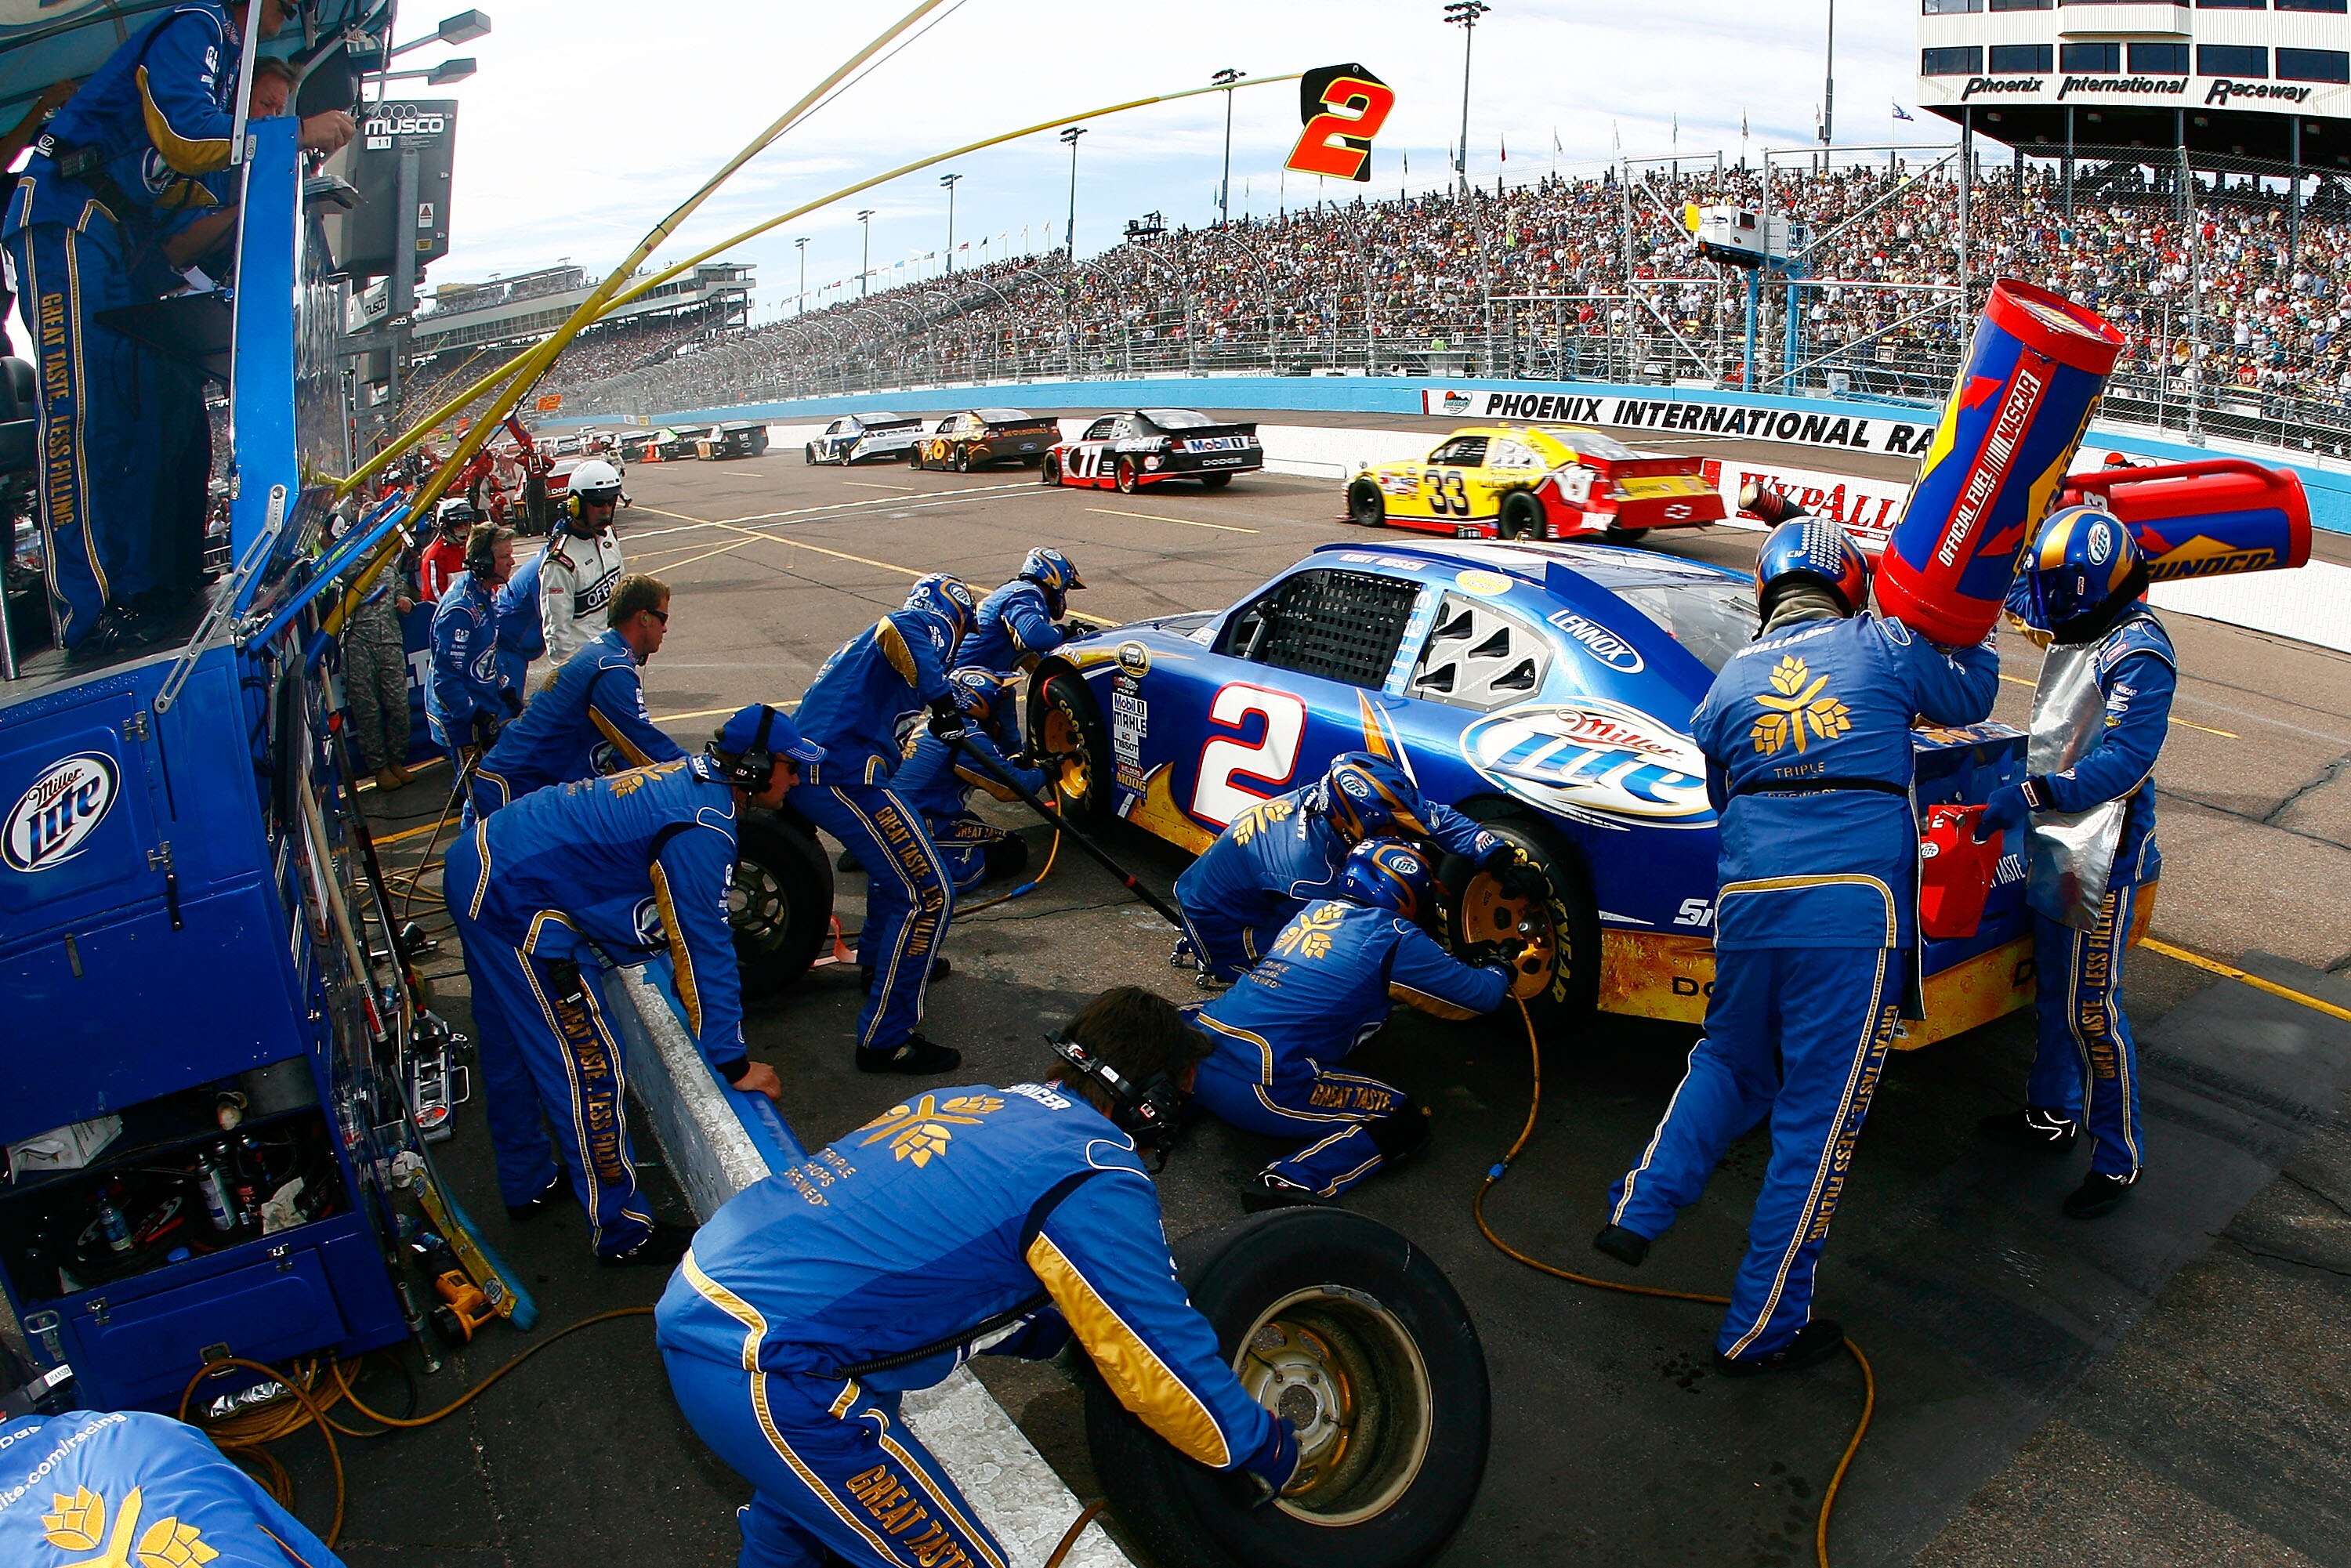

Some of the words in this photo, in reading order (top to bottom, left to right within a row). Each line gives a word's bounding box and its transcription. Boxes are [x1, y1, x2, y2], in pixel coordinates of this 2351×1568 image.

[1962, 77, 2045, 102] Phoenix
[2057, 76, 2189, 101] International
[2204, 79, 2312, 106] Raceway
[1284, 77, 1395, 179] 2
[42, 292, 66, 347] GREAT
[536, 393, 563, 411] 12
[49, 415, 71, 461] LESS
[951, 431, 984, 442] UPS
[1485, 393, 1603, 423] PHOENIX
[1613, 400, 1875, 449] INTERNATIONAL
[933, 436, 946, 460] 6
[1190, 439, 1230, 453] Mobil
[1232, 436, 1244, 449] 1
[1202, 457, 1243, 466] DODGE
[1937, 504, 1976, 568] OFFICIAL
[1965, 465, 1994, 509] FUEL
[1995, 368, 2042, 446] NASCAR
[1423, 469, 1470, 517] 33
[1338, 553, 1379, 564] KURT
[1375, 557, 1427, 572] BUSCH
[1545, 609, 1632, 663] LENNOX
[1735, 625, 1836, 660] WILLIAMS
[1114, 694, 1136, 712] Mobil
[1114, 712, 1147, 734] MAHLE
[1556, 708, 1685, 756] Miller
[1114, 738, 1139, 753] TISSOT
[1190, 680, 1308, 829] 2
[1116, 772, 1148, 791] MOOG
[1482, 730, 1707, 806] Lite
[1773, 762, 1825, 779] TRIPLE
[27, 767, 85, 809] Miller
[25, 775, 102, 869] Lite
[874, 806, 911, 845] GREAT
[1930, 814, 1945, 828] 2
[2085, 951, 2109, 987] LESS
[588, 1091, 614, 1132] LESS
[1309, 1084, 1353, 1109] GREAT
[819, 1147, 857, 1179] TRIPLE
[1833, 1124, 1860, 1172] LESS
[803, 1161, 836, 1187] HOPS
[846, 1464, 929, 1535] GREAT
